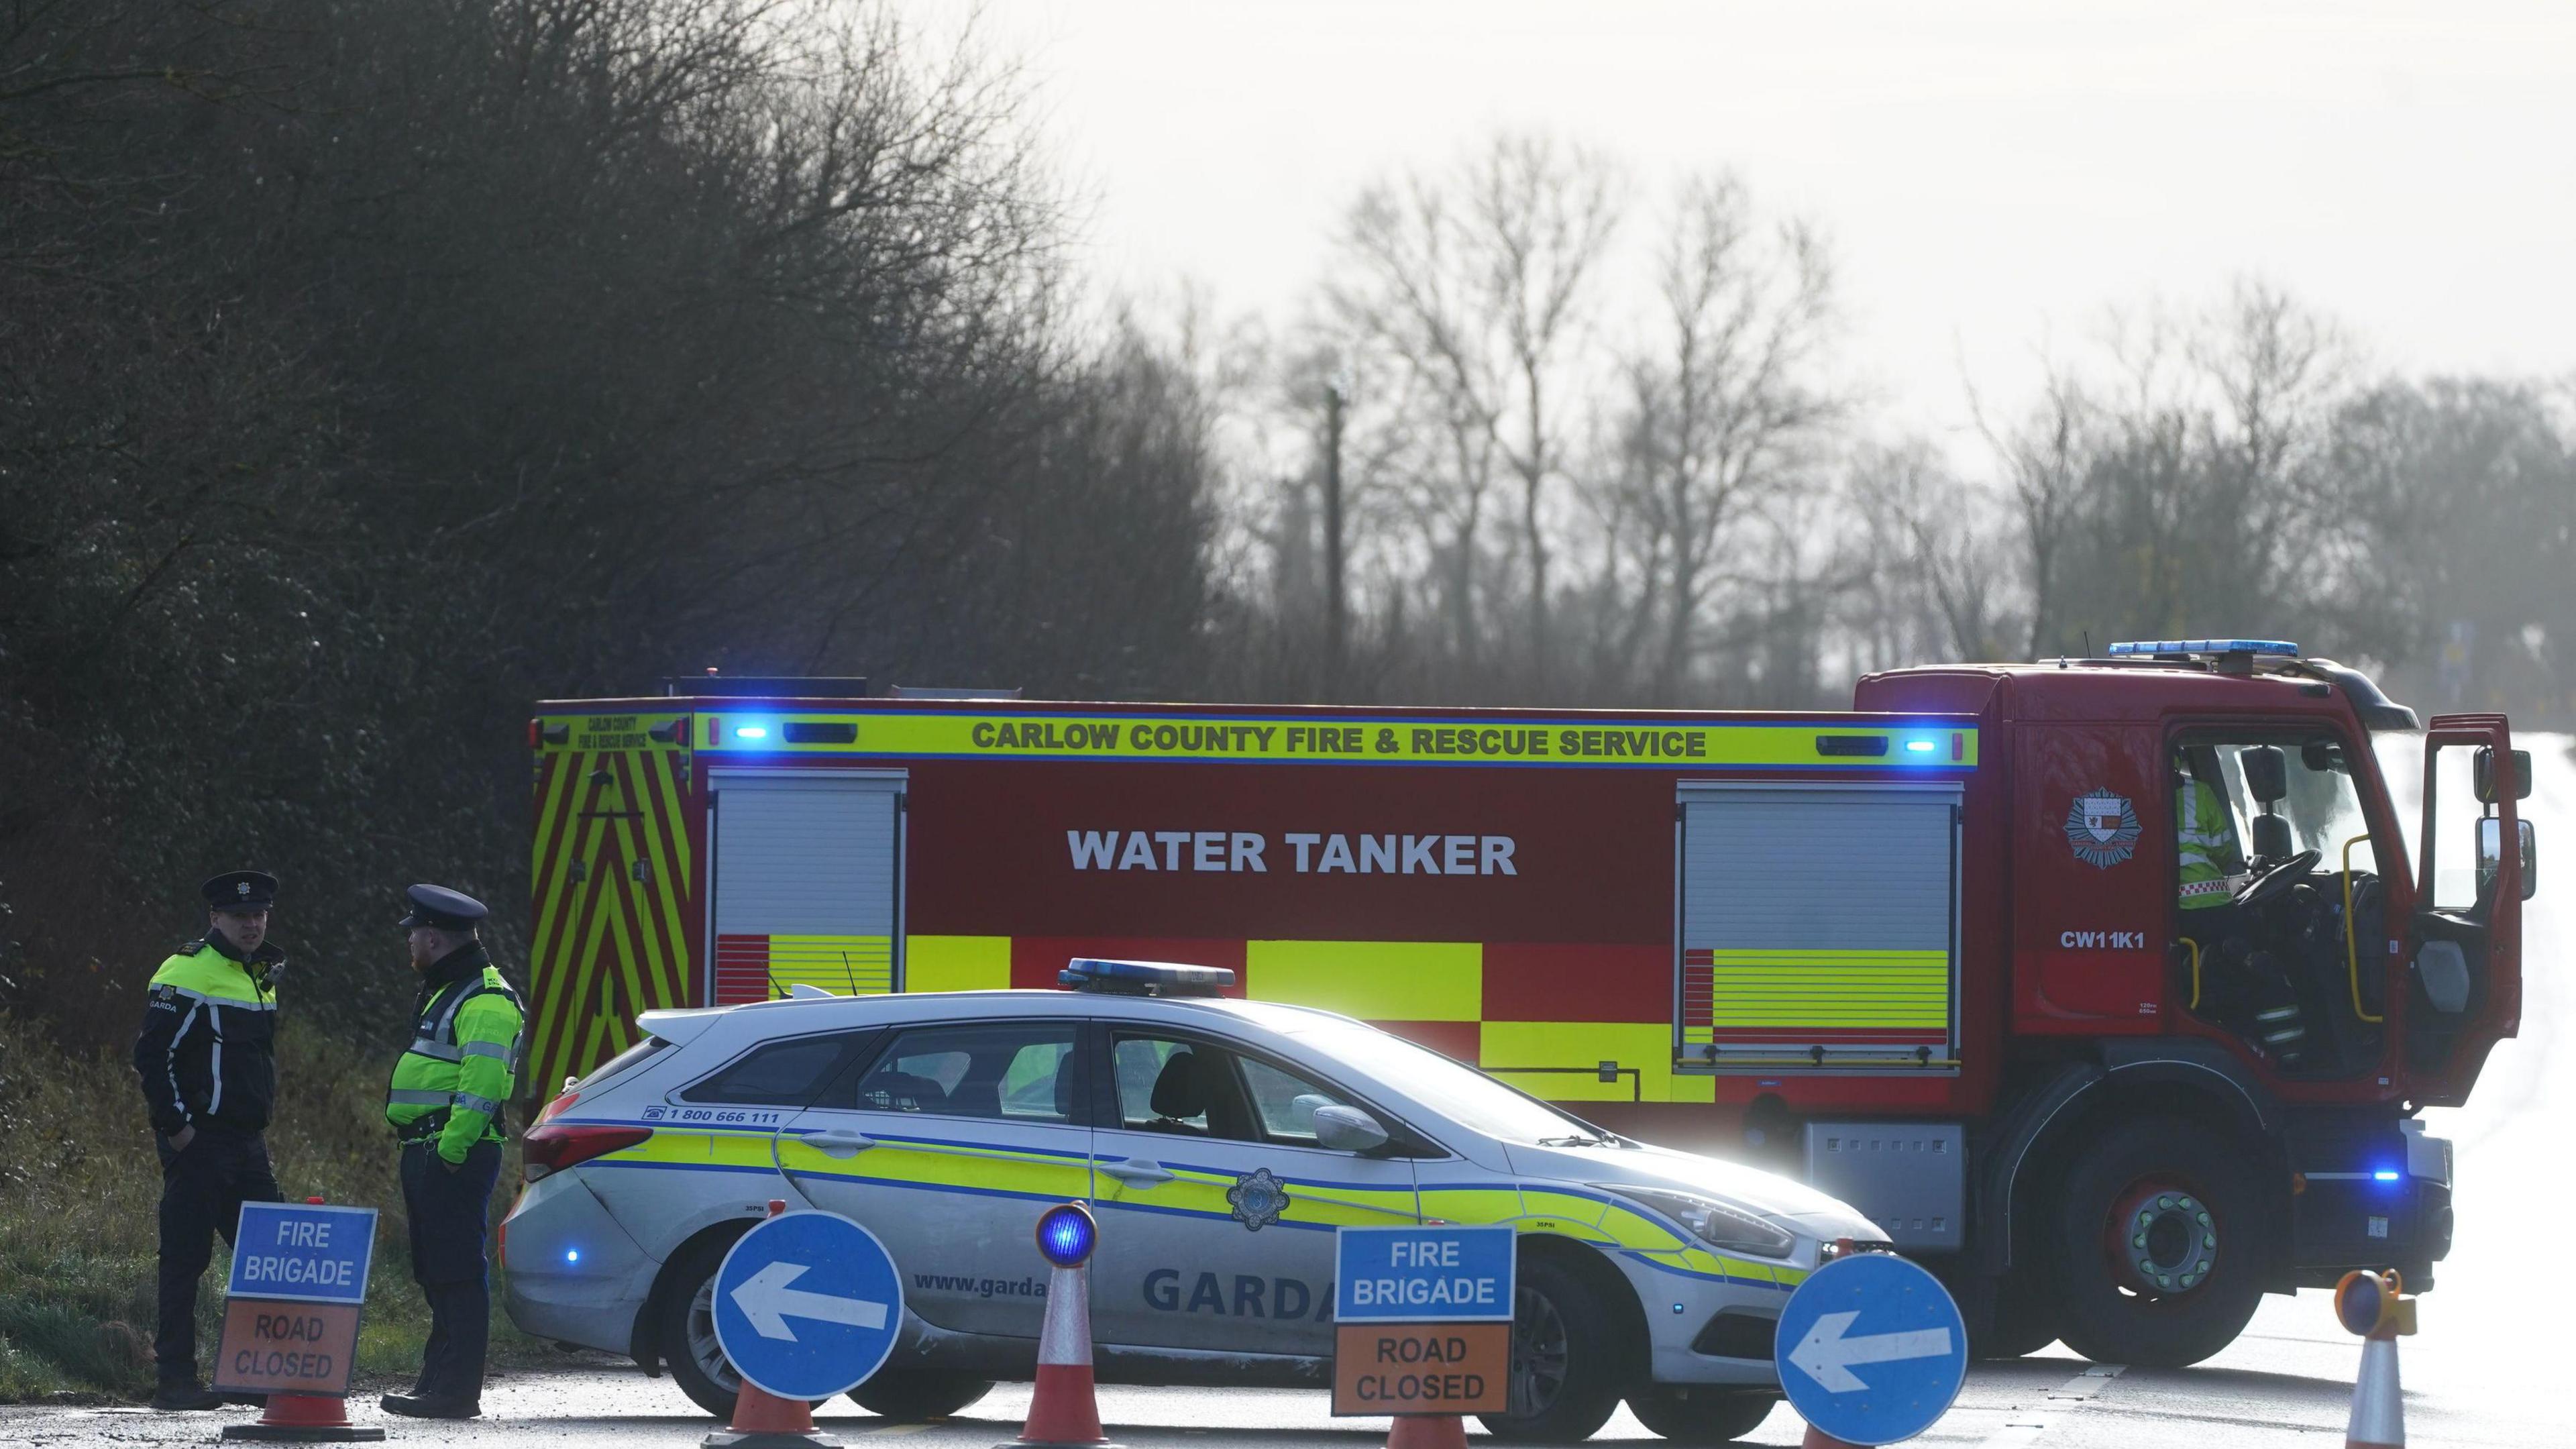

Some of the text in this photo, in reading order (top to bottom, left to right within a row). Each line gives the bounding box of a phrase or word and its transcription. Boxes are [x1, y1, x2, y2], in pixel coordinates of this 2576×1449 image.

[588, 716, 637, 732] CARLOW COUNTY
[578, 734, 593, 749] FIRE
[599, 733, 621, 748] RESCUE
[622, 733, 646, 748] SERVICE
[972, 722, 1706, 757] CARLOW COUNTY FIRE & RESCUE SERVICE
[1067, 830, 1517, 875] WATER TANKER
[150, 1000, 177, 1013] GARDA
[670, 1109, 780, 1123] 1 800 666 111
[277, 1220, 331, 1248] FIRE
[1391, 1241, 1460, 1267] FIRE
[244, 1255, 354, 1286] BRIGADE
[914, 1274, 1049, 1298] www.garda
[1354, 1278, 1495, 1305] BRIGADE
[255, 1314, 324, 1342] ROAD
[1377, 1338, 1466, 1363] ROAD
[235, 1349, 332, 1379] CLOSED
[1356, 1375, 1485, 1401] CLOSED
